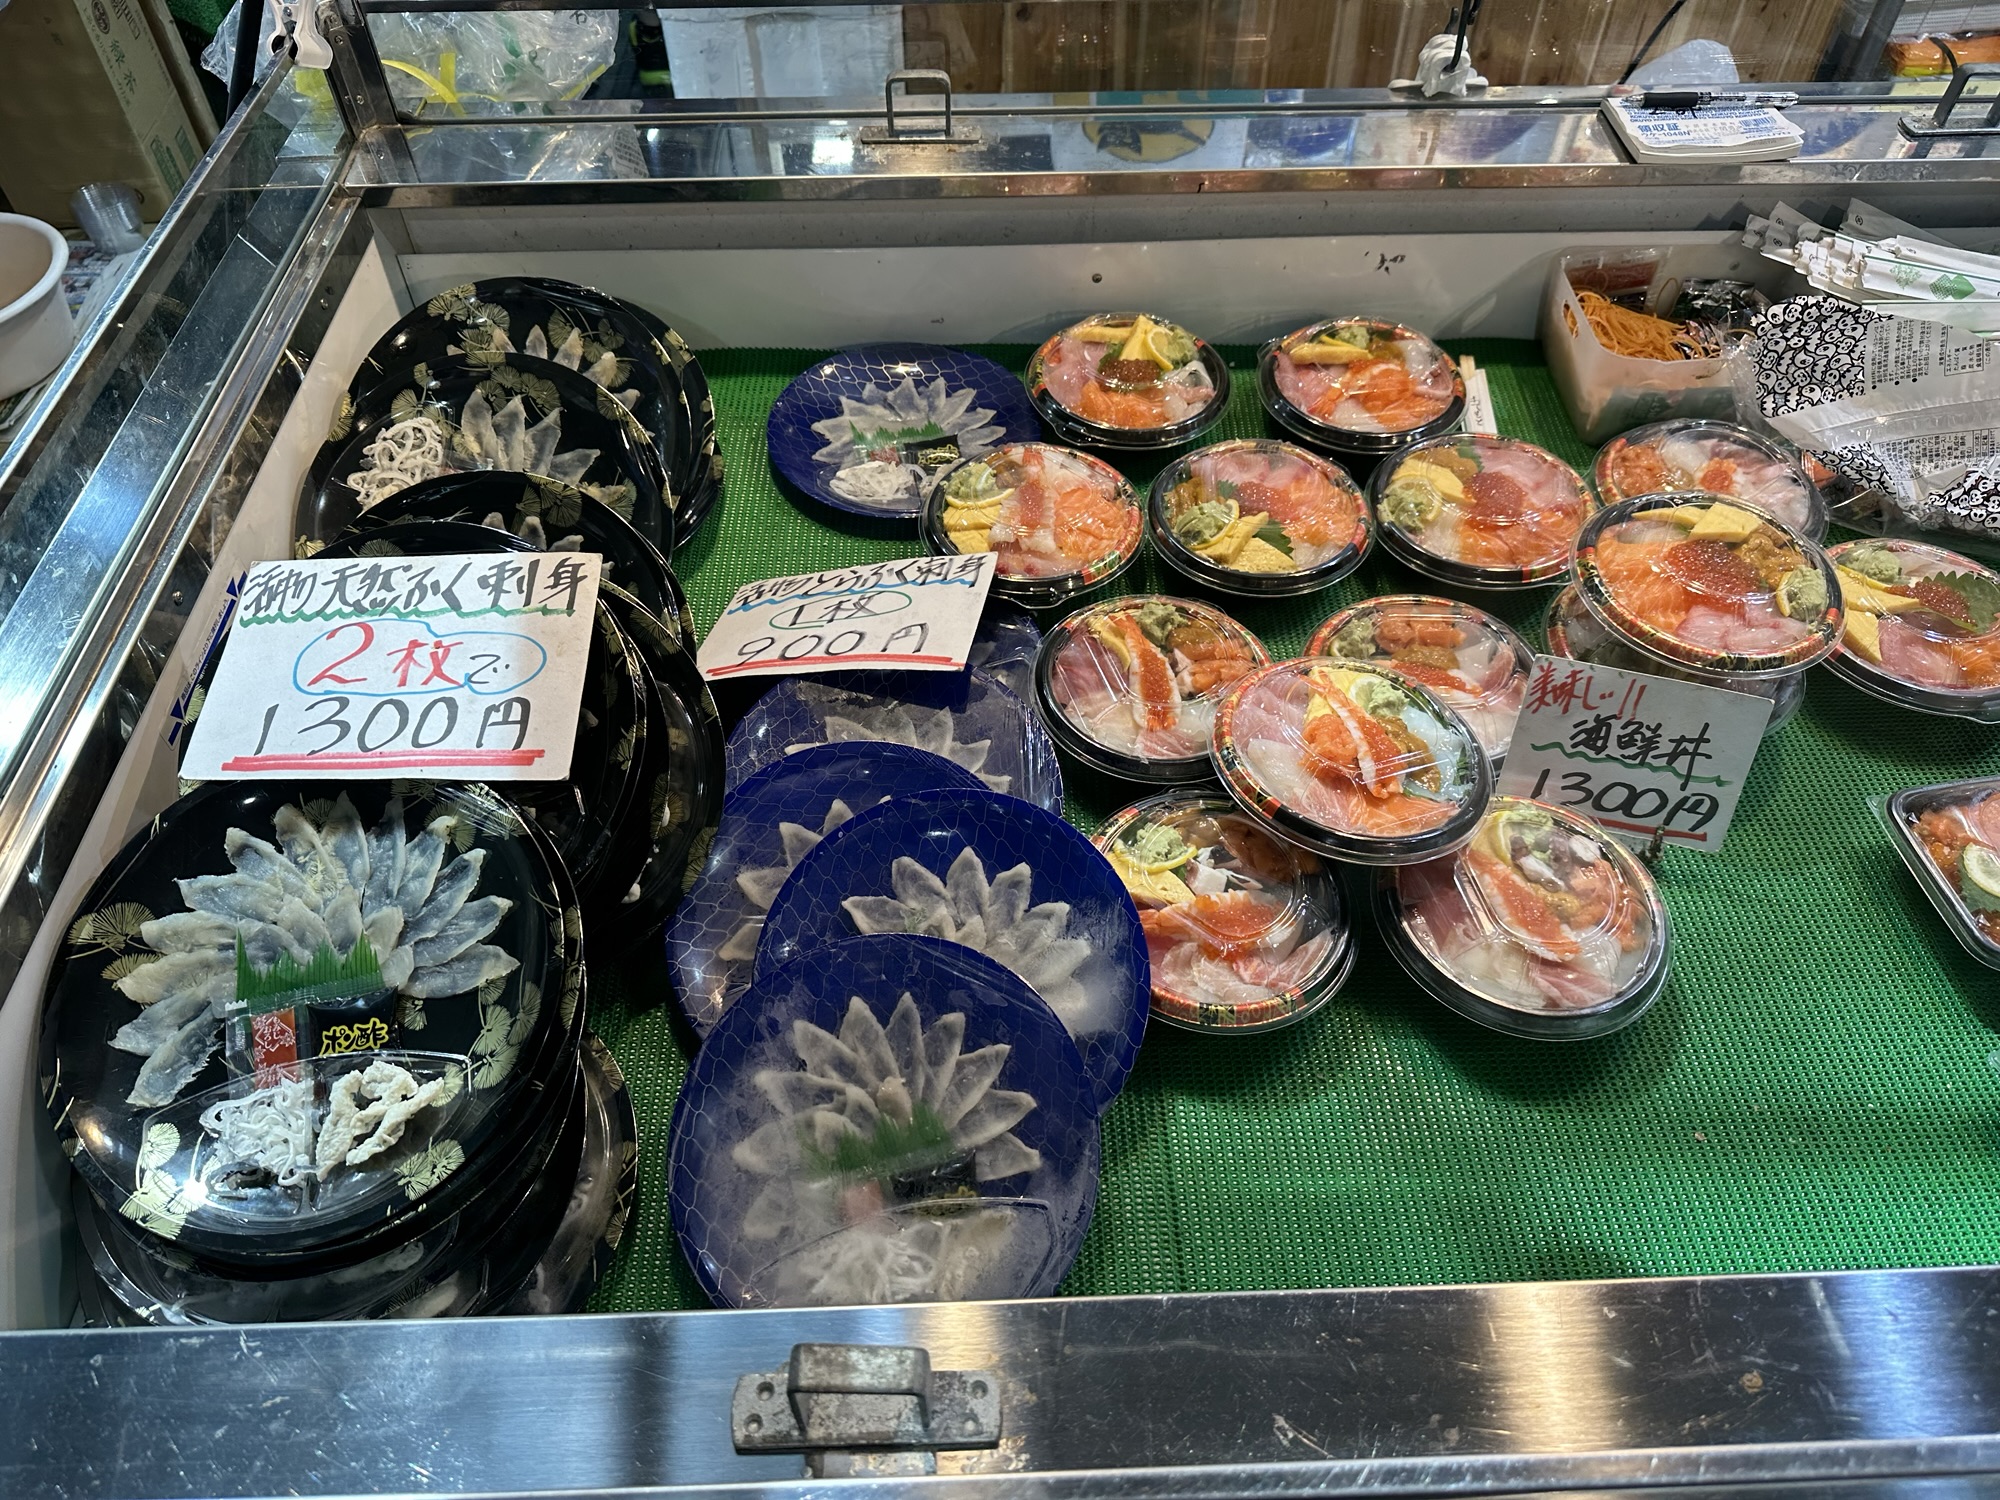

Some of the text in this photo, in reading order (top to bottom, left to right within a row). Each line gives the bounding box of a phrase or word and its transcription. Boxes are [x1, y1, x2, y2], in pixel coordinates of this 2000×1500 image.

[307, 622, 511, 688] 2枚で
[737, 622, 930, 667] 900円
[255, 696, 531, 756] 1300円
[1530, 768, 1720, 833] 1300円
[319, 1017, 389, 1058] ポン酢
